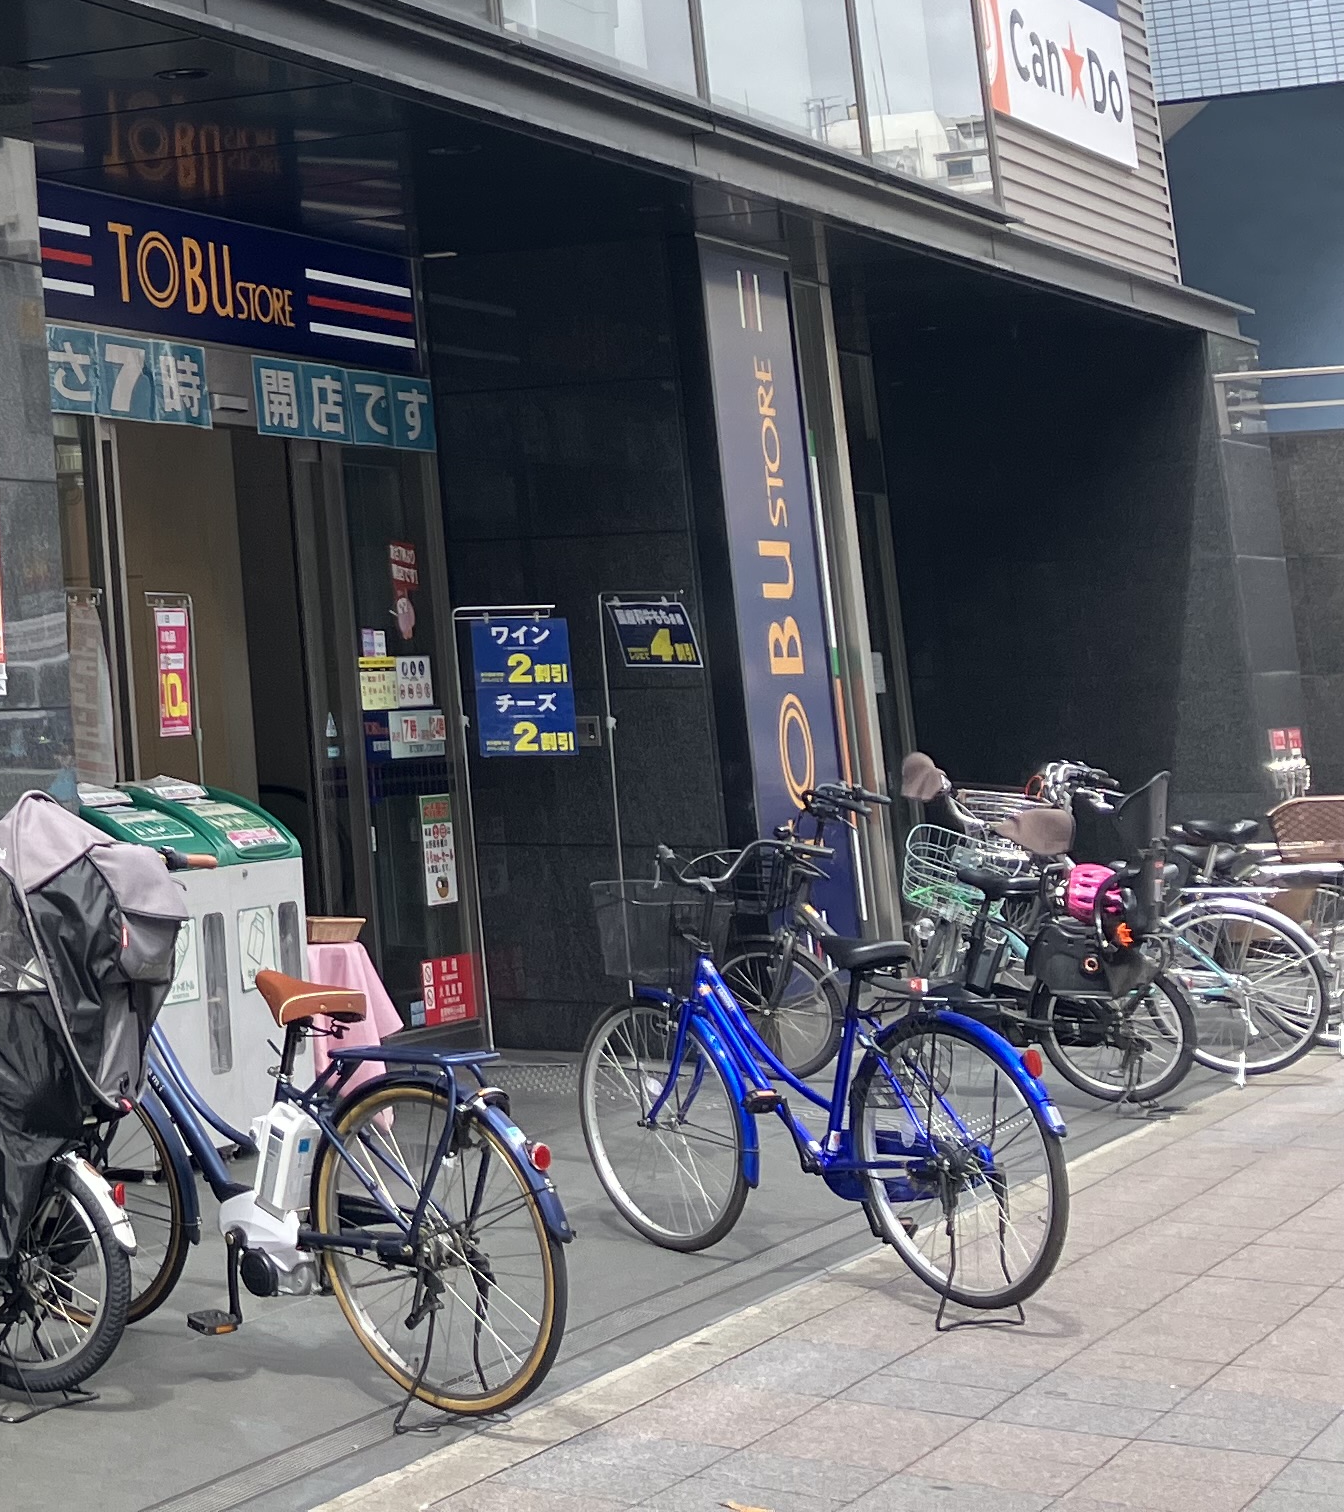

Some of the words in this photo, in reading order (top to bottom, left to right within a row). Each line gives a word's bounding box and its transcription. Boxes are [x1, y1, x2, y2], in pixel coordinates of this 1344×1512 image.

[108, 221, 234, 317] TOBU
[235, 282, 296, 328] STORE
[259, 368, 427, 441] 開店です
[753, 355, 788, 528] STORE
[490, 625, 550, 645] ワイン
[507, 653, 568, 684] 2割引
[495, 693, 557, 713] チーズ
[513, 721, 574, 752] 2割引
